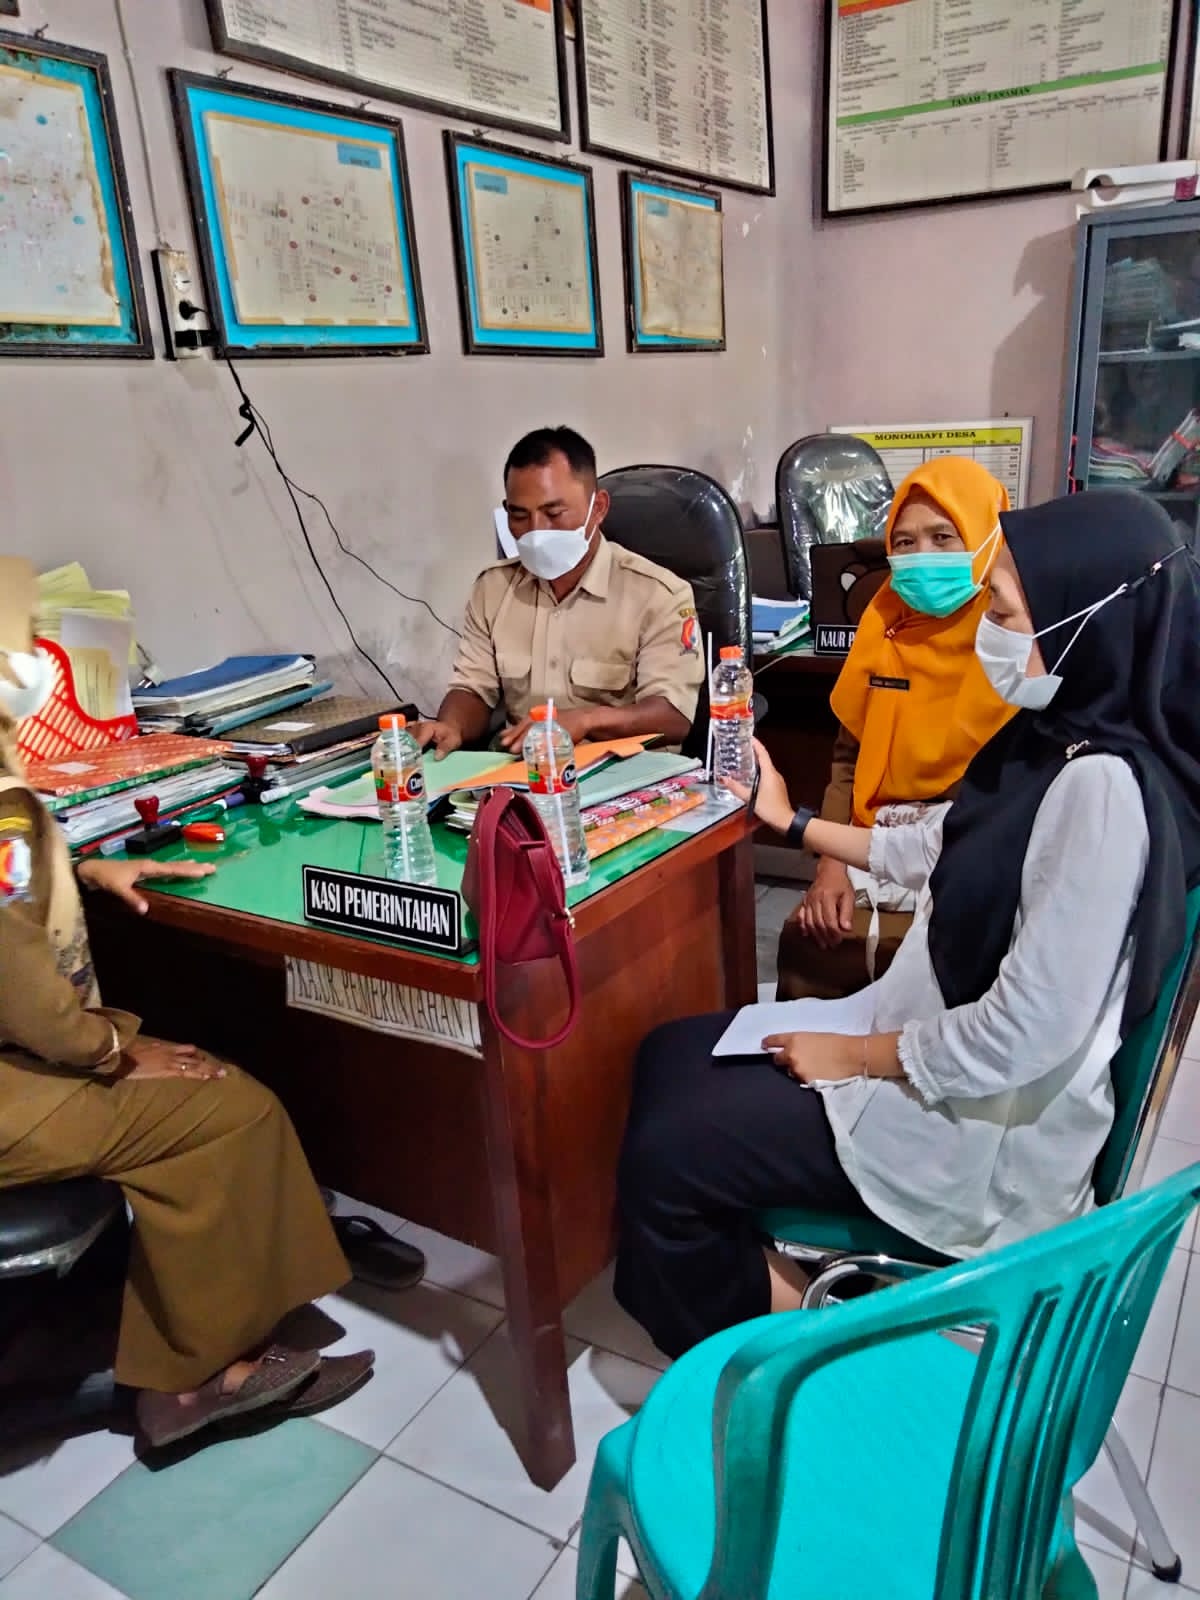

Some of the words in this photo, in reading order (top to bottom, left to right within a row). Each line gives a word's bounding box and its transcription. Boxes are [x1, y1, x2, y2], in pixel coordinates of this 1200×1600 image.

[874, 432, 943, 441] MONOGRAFI
[946, 431, 977, 439] DESA
[820, 630, 846, 648] KAUR
[311, 879, 341, 913] KASI
[344, 885, 450, 936] PEMERINTAHAN
